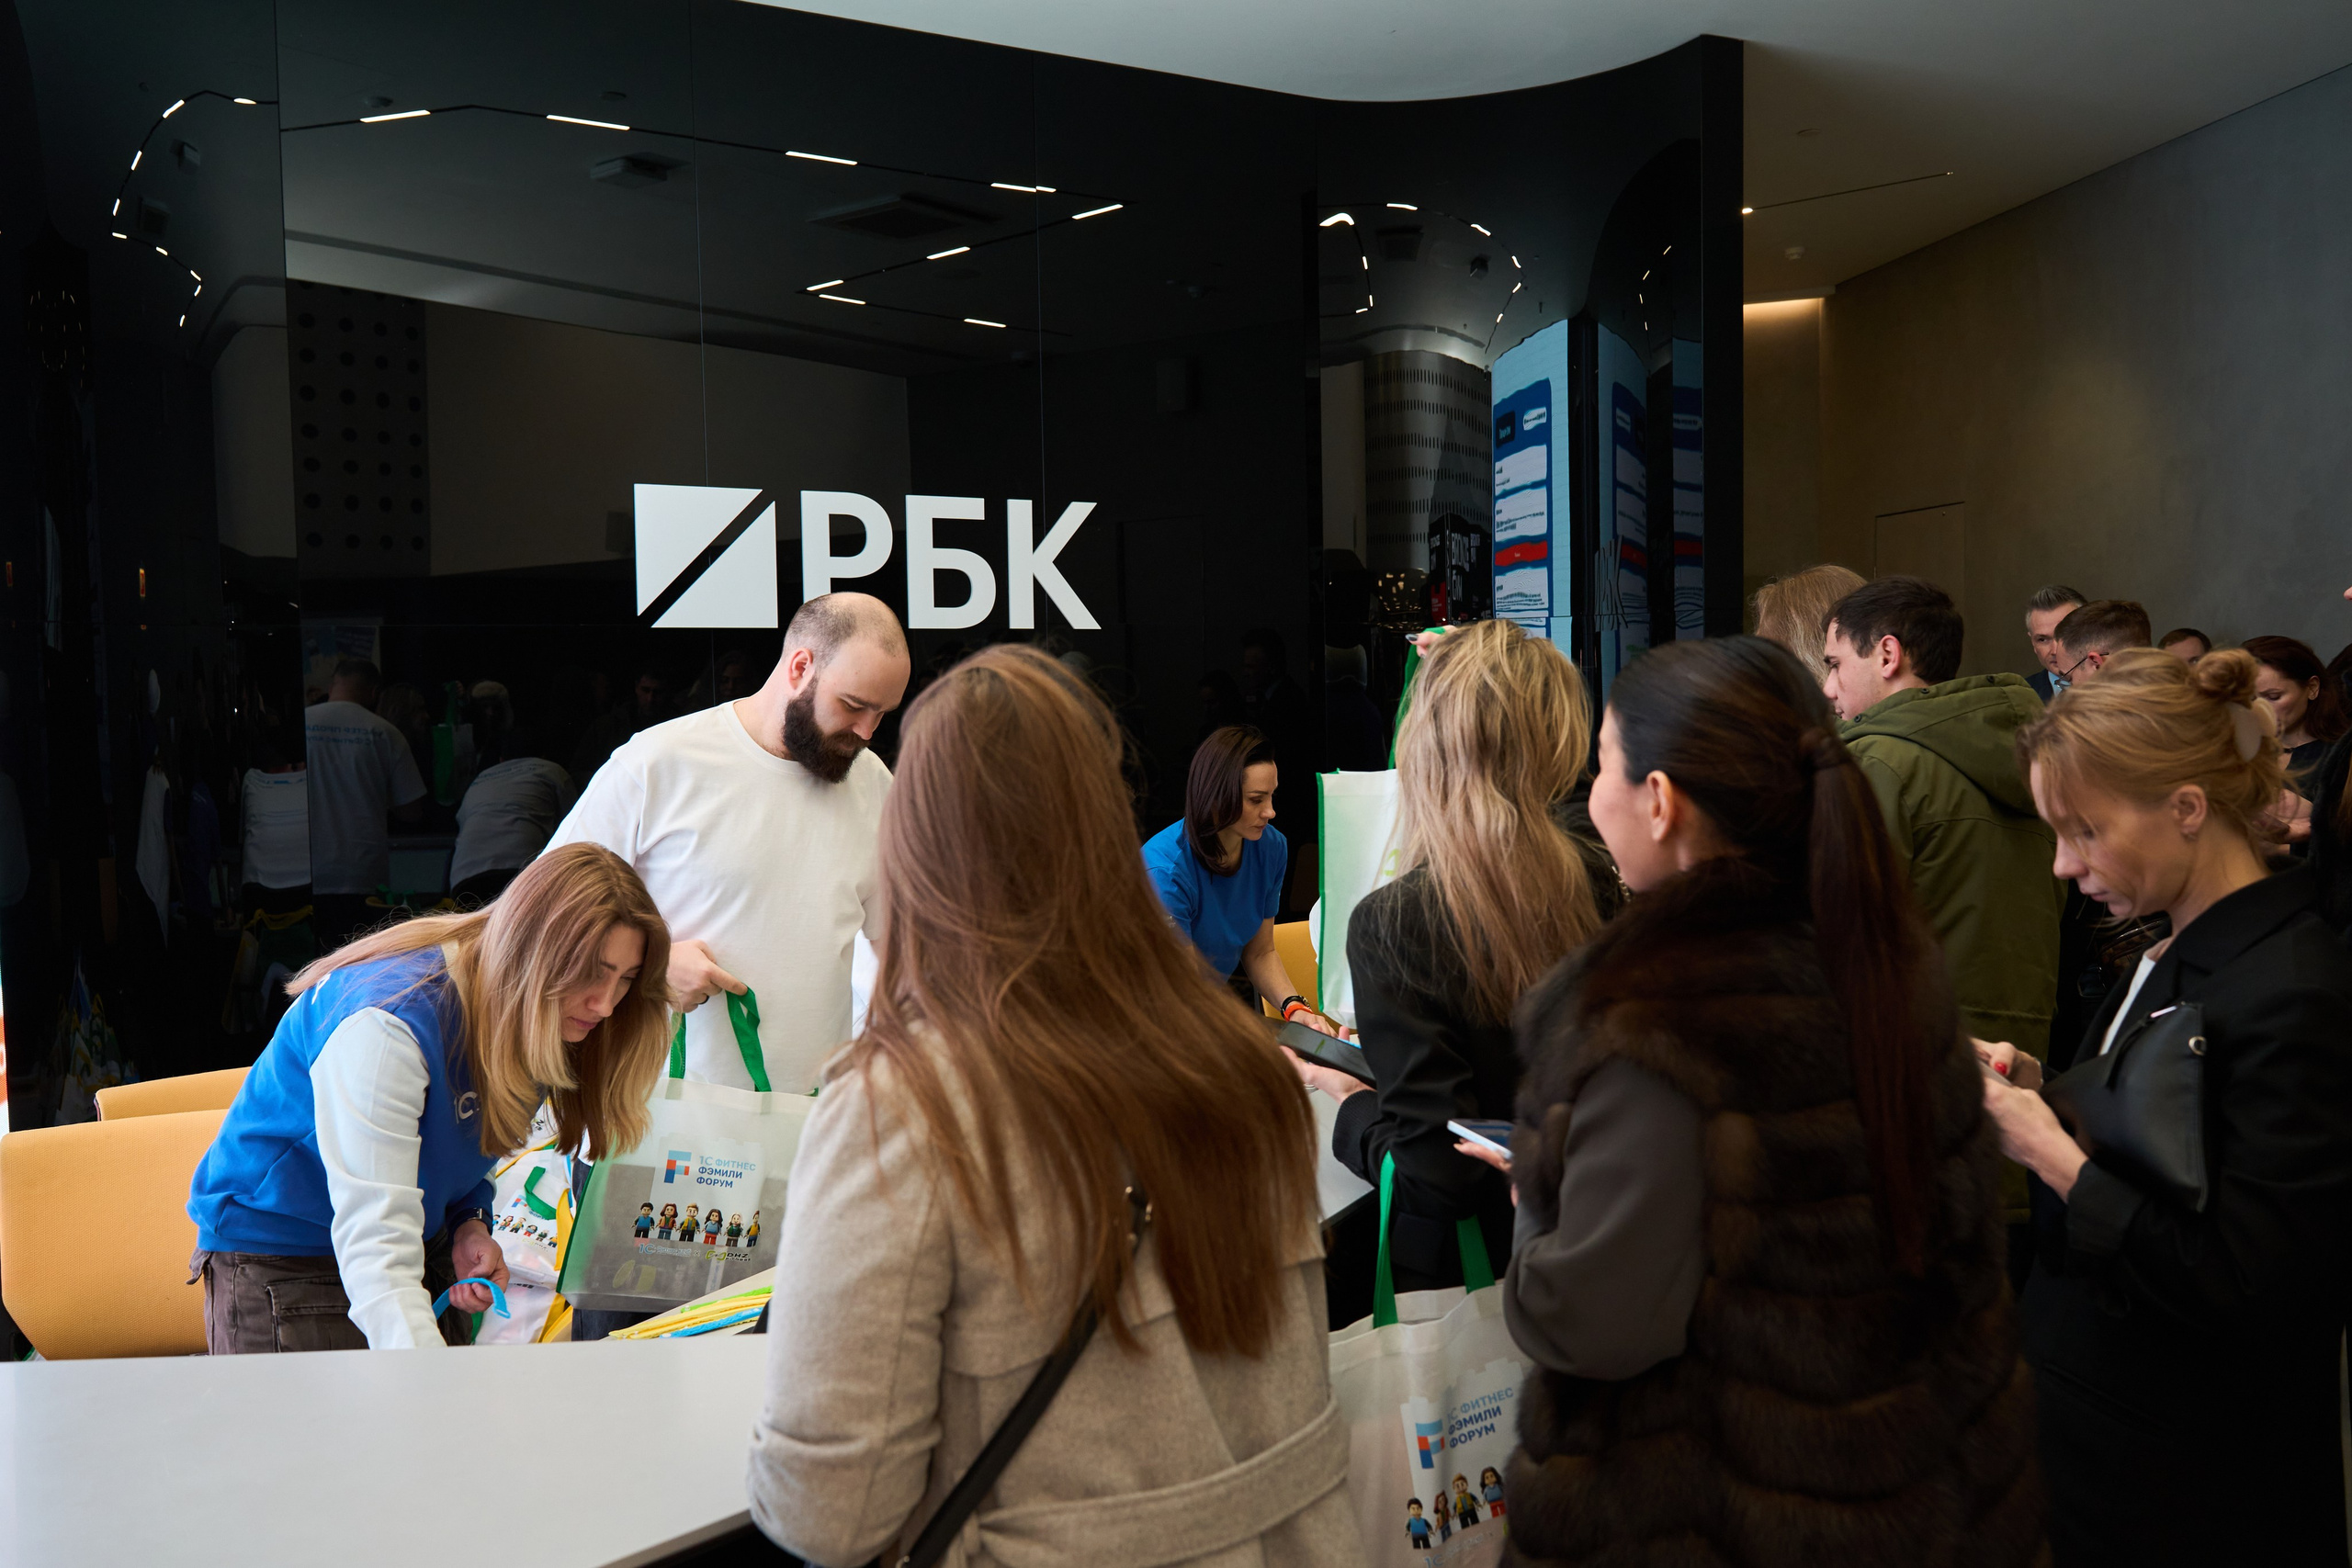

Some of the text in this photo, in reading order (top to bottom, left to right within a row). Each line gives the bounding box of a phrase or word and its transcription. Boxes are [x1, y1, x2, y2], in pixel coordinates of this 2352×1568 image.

[801, 491, 1101, 629] РБК
[697, 1166, 743, 1179] ФЭМИЛИ
[699, 1156, 757, 1171] 1С ФИТНЕС
[695, 1176, 734, 1189] ФОРУМ
[1460, 1387, 1514, 1414] ФИТНЕС
[1448, 1405, 1502, 1436] ФЭМИЛИ
[1449, 1422, 1497, 1449] ФОРУМ
